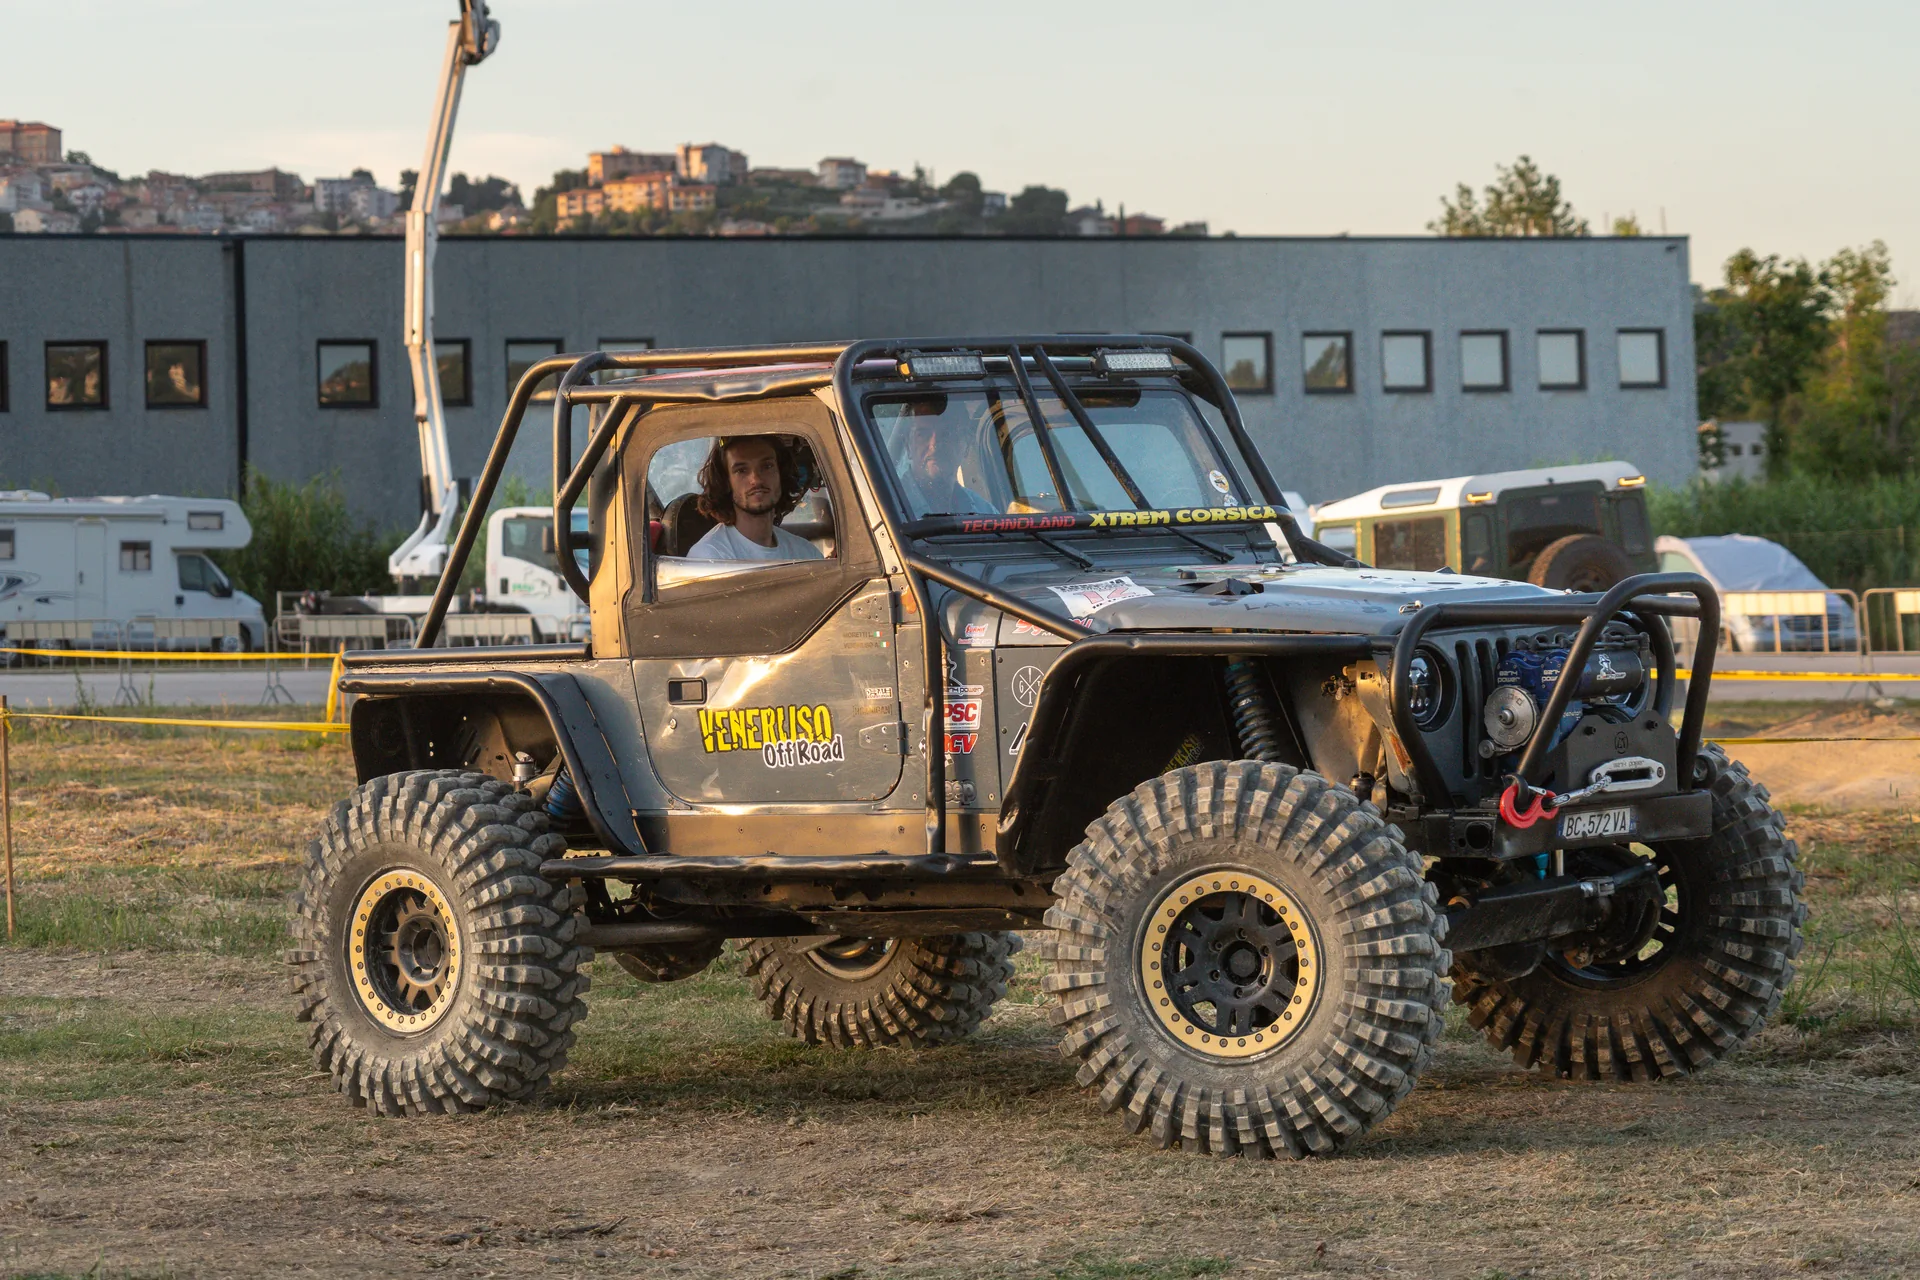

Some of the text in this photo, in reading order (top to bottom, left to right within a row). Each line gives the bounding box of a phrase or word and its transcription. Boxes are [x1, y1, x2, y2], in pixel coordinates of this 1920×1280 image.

[962, 505, 1278, 533] TECHNOLAND XTREM CORSICA
[697, 704, 833, 753] VENERUSO
[763, 735, 844, 766] Off Road
[944, 779, 977, 806] eep
